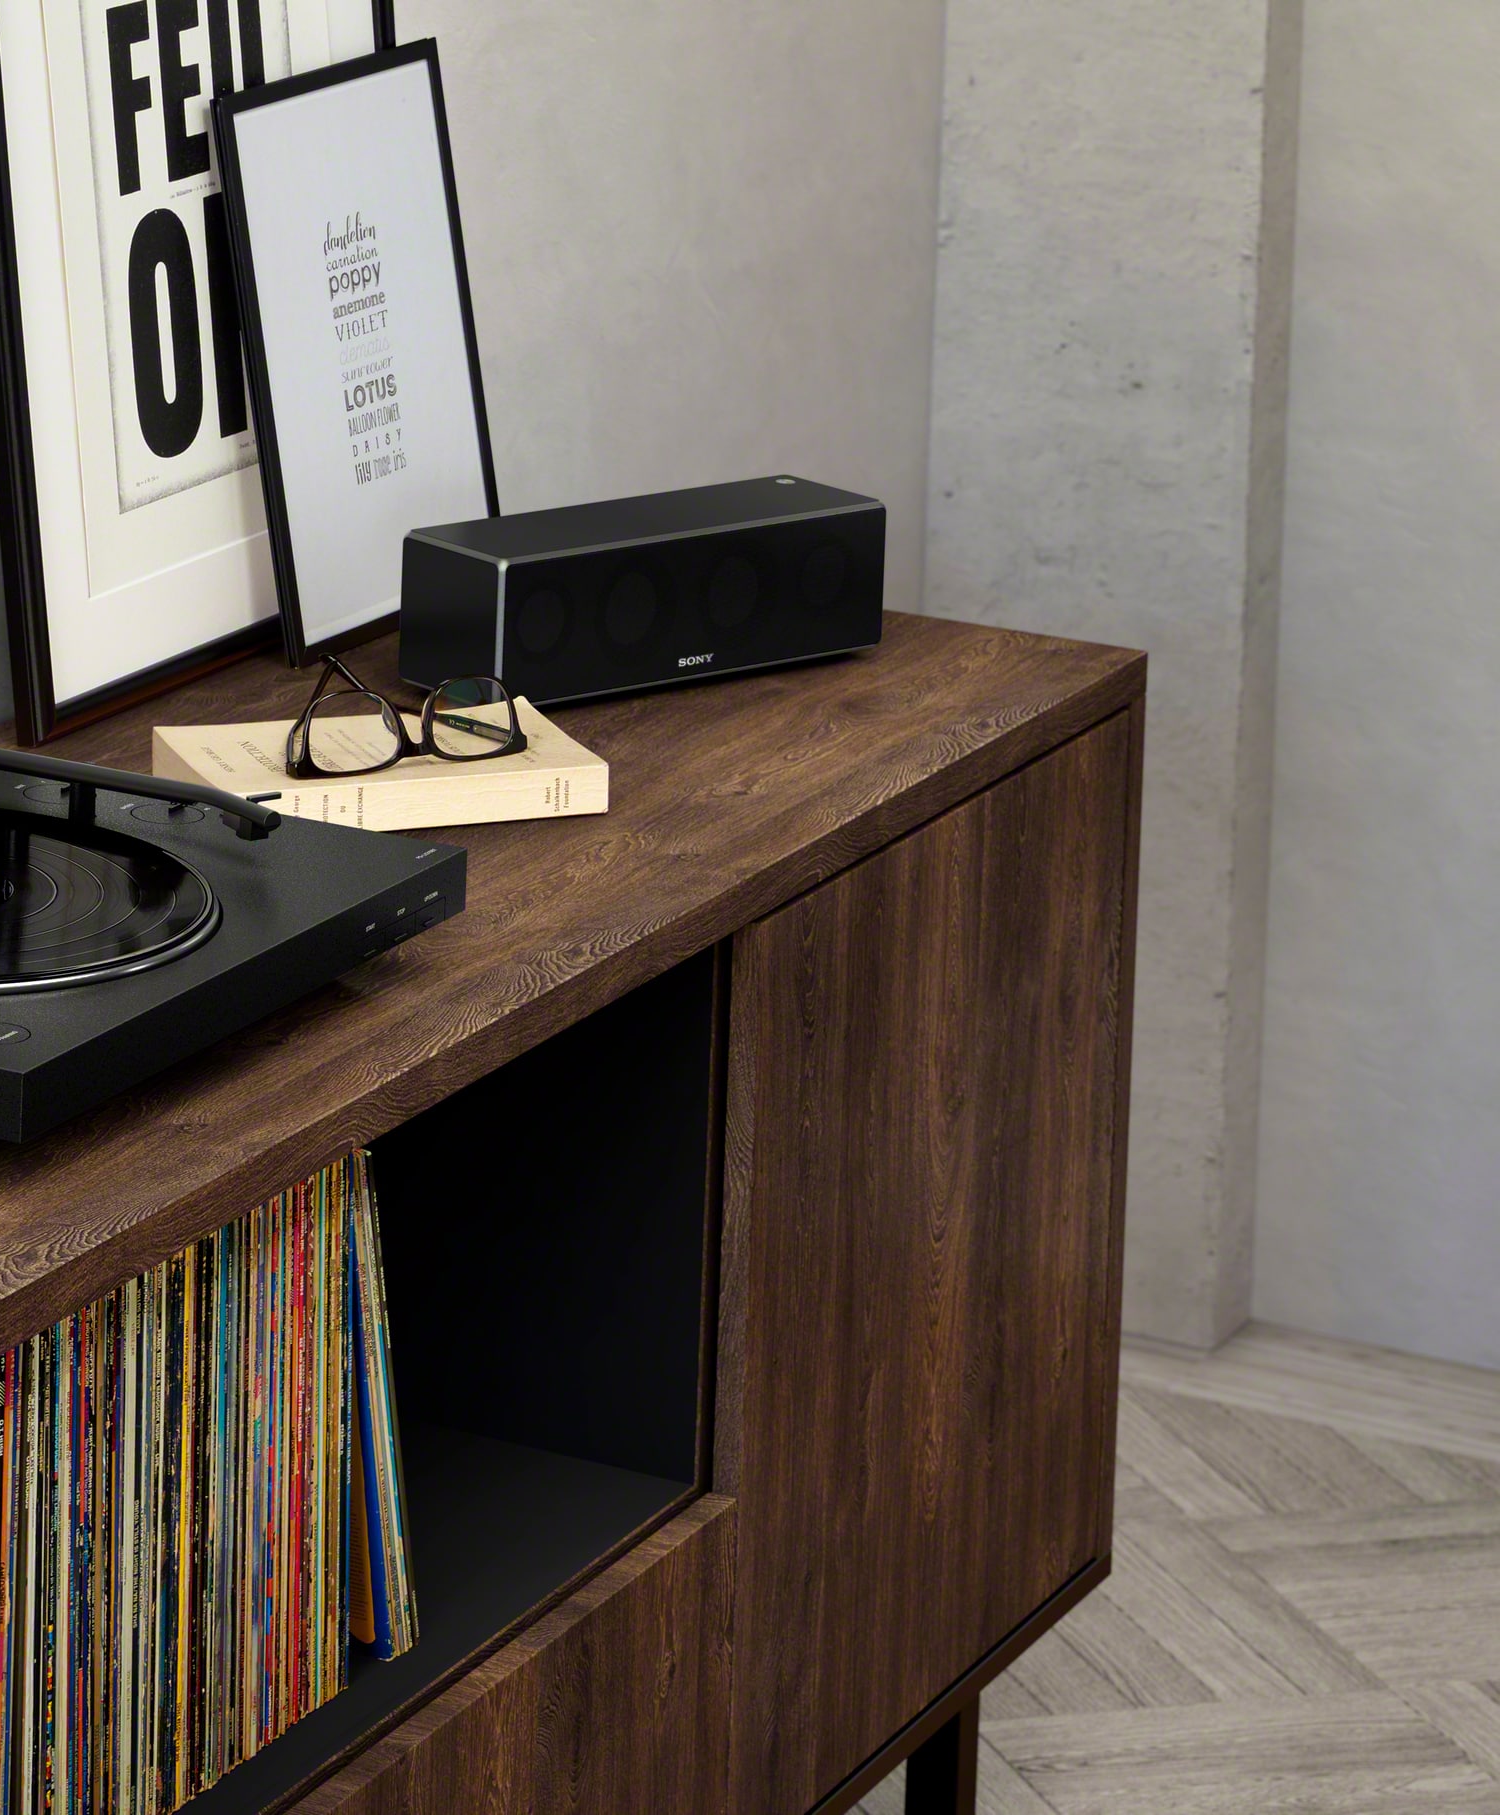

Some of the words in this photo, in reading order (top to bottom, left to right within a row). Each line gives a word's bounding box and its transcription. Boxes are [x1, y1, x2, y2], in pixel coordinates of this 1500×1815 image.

[323, 211, 377, 256] dandelion
[325, 247, 379, 272] carnation
[328, 261, 382, 300] poppy
[332, 290, 387, 320] anemone
[334, 308, 389, 342] VIOLET
[340, 356, 394, 384] sunflower
[343, 373, 398, 413] LOTUS
[348, 411, 377, 438] BALLOON
[376, 402, 401, 428] FLOWER
[352, 428, 403, 457] DAISY
[354, 460, 373, 486] lily
[372, 455, 392, 481] rose
[392, 448, 407, 472] iris
[678, 653, 715, 668] SONY
